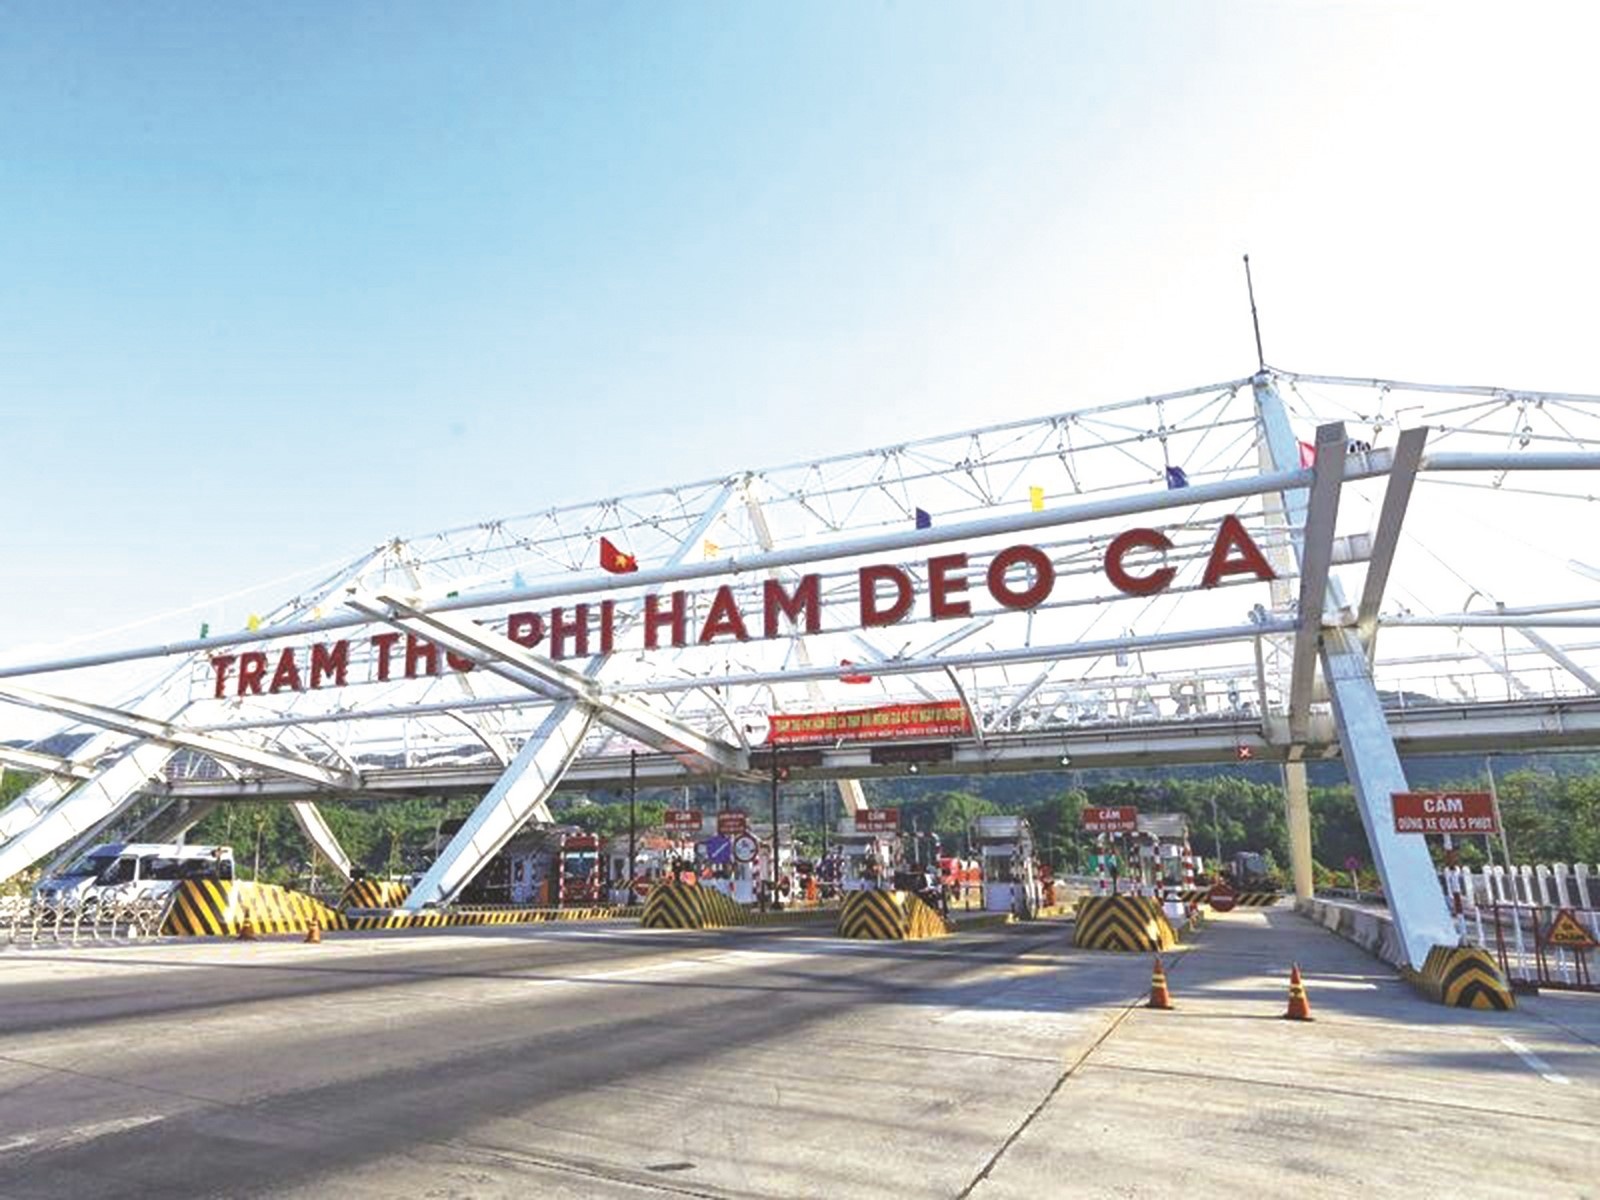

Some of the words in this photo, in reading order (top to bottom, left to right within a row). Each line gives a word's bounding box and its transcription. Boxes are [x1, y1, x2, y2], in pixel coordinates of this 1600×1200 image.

[211, 639, 350, 699] TRAM
[643, 574, 824, 651] HAM
[859, 544, 1056, 629] DEO
[1104, 514, 1279, 598] CA
